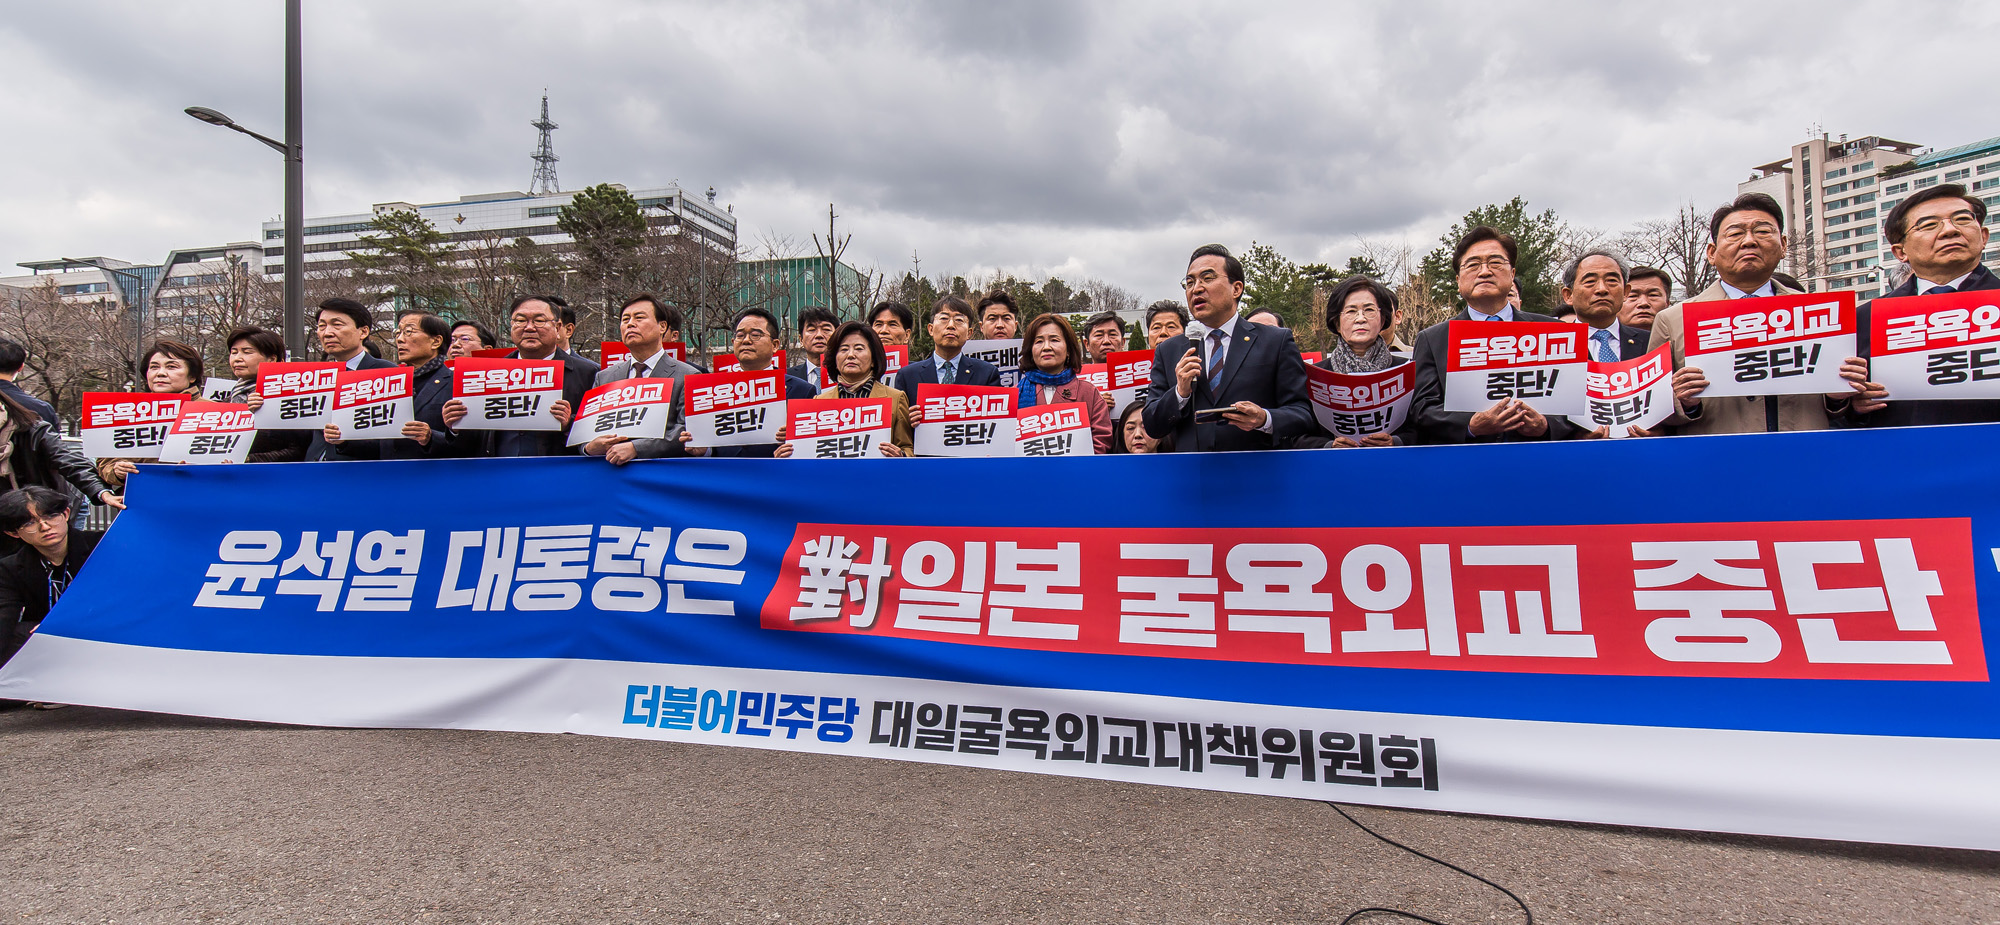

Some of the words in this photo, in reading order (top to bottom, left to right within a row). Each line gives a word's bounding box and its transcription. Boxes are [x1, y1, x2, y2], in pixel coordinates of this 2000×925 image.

[1697, 300, 1842, 351] 굴욕외교
[1459, 331, 1577, 368] 굴욕외교
[1733, 343, 1822, 383] 중단!
[262, 367, 337, 397] 굴욕외교
[339, 374, 407, 406] 굴욕외교
[462, 366, 555, 394] 굴욕외교
[1310, 372, 1406, 409] 굴욕외교
[1486, 368, 1560, 401] 중단!
[1586, 353, 1664, 397] 욕외교
[279, 395, 328, 420] 중단!
[484, 394, 541, 421] 중단!
[583, 383, 664, 414] 굴욕외교
[692, 376, 778, 413] 굴욕외교
[924, 393, 1010, 420] 굴욕외교
[1590, 389, 1651, 426] 중단!
[90, 399, 181, 426] 굴욕외교
[179, 408, 255, 433] 굴욕외교
[353, 402, 397, 430] 중단!
[594, 406, 649, 433] 중단!
[714, 406, 766, 437] 중단!
[794, 403, 883, 437] 굴욕외교
[1333, 405, 1393, 436] 중단!
[113, 425, 168, 449] 중단!
[188, 434, 241, 456] 중단!
[815, 433, 872, 458] 중단!
[943, 422, 996, 447] 중단!
[1023, 433, 1072, 457] 중단!
[192, 529, 425, 612] 윤석열
[435, 524, 748, 616] 대통령은
[789, 534, 1084, 642] 對일본
[1117, 542, 1598, 659] 굴욕외교
[1631, 537, 1954, 665] 중단
[622, 683, 860, 743] 더불어민주당
[869, 700, 1440, 791] 대일굴욕외교대책위원회
